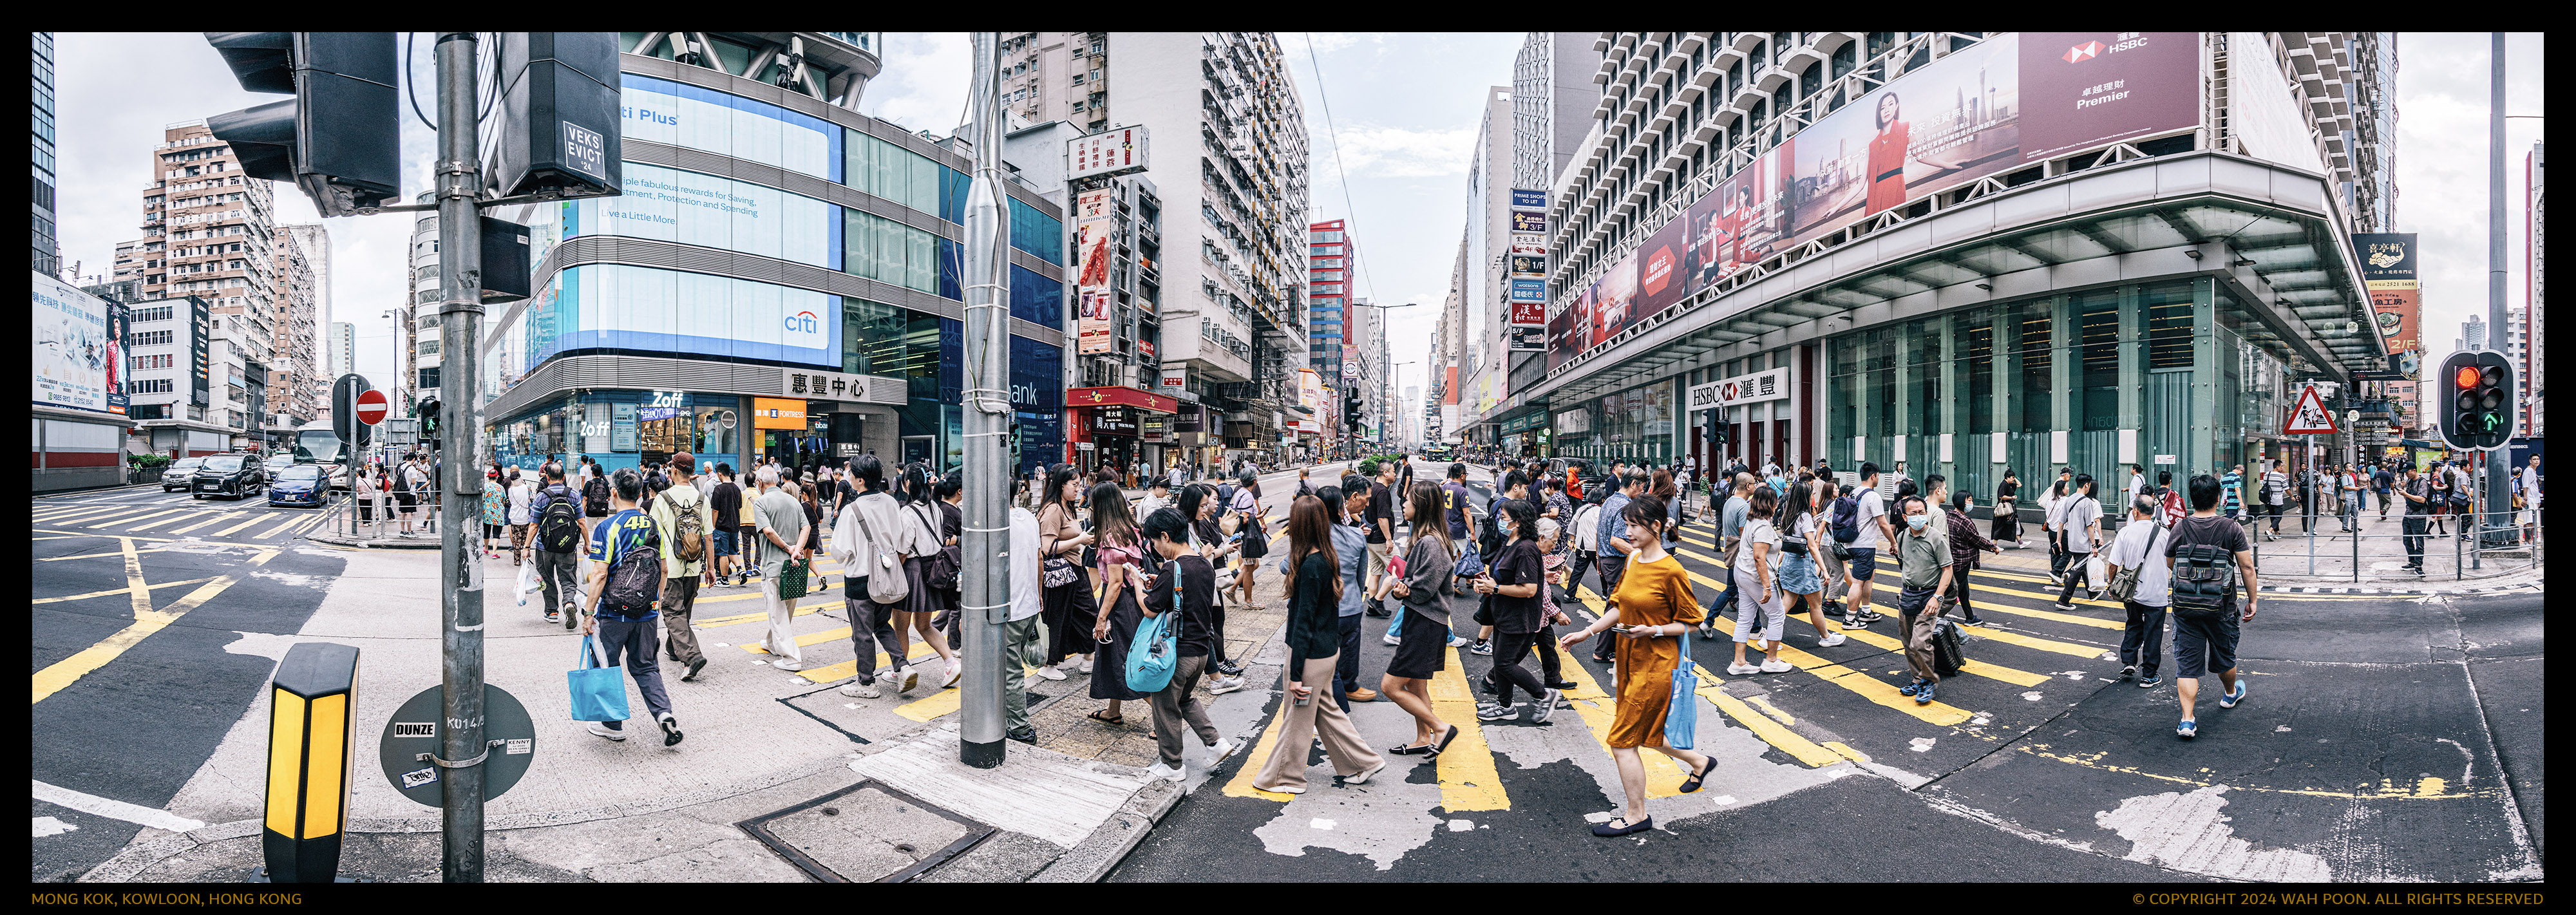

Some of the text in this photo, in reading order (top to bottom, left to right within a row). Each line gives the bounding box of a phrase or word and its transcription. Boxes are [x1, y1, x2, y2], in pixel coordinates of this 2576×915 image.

[2109, 37, 2148, 53] HSBC
[2082, 79, 2125, 97] 卓越理財
[2077, 91, 2130, 109] Premier
[640, 109, 677, 126] Plus
[1907, 104, 1972, 138] 未來 投資無界
[569, 127, 600, 149] VEKS
[567, 142, 601, 165] EVICT
[1820, 164, 1834, 178] 以前
[641, 178, 678, 192] fabulous
[681, 186, 713, 198] rewards
[715, 190, 726, 200] for
[728, 194, 757, 207] Saving,
[1079, 194, 1109, 205] 買二送一
[658, 193, 701, 206] Protection
[703, 201, 719, 210] and
[721, 202, 758, 218] Spending
[1088, 208, 1100, 217] 3天
[601, 209, 620, 218] Live
[629, 211, 651, 221] Little
[1649, 255, 1666, 274] 理財女王
[32, 291, 59, 310] 領先科技
[784, 312, 817, 334] citi
[2391, 340, 2415, 349] 2/F
[791, 373, 864, 397] 惠豐中心
[1693, 374, 1776, 406] HSBC 滙豐
[652, 391, 683, 408] Zoff
[779, 410, 804, 419] FORTRESS
[580, 421, 610, 437] Zoff
[1444, 489, 1454, 509] 3
[1464, 496, 1470, 504] 3
[623, 514, 651, 530] 46
[558, 535, 569, 546] adidas
[395, 724, 433, 735] DUNZE
